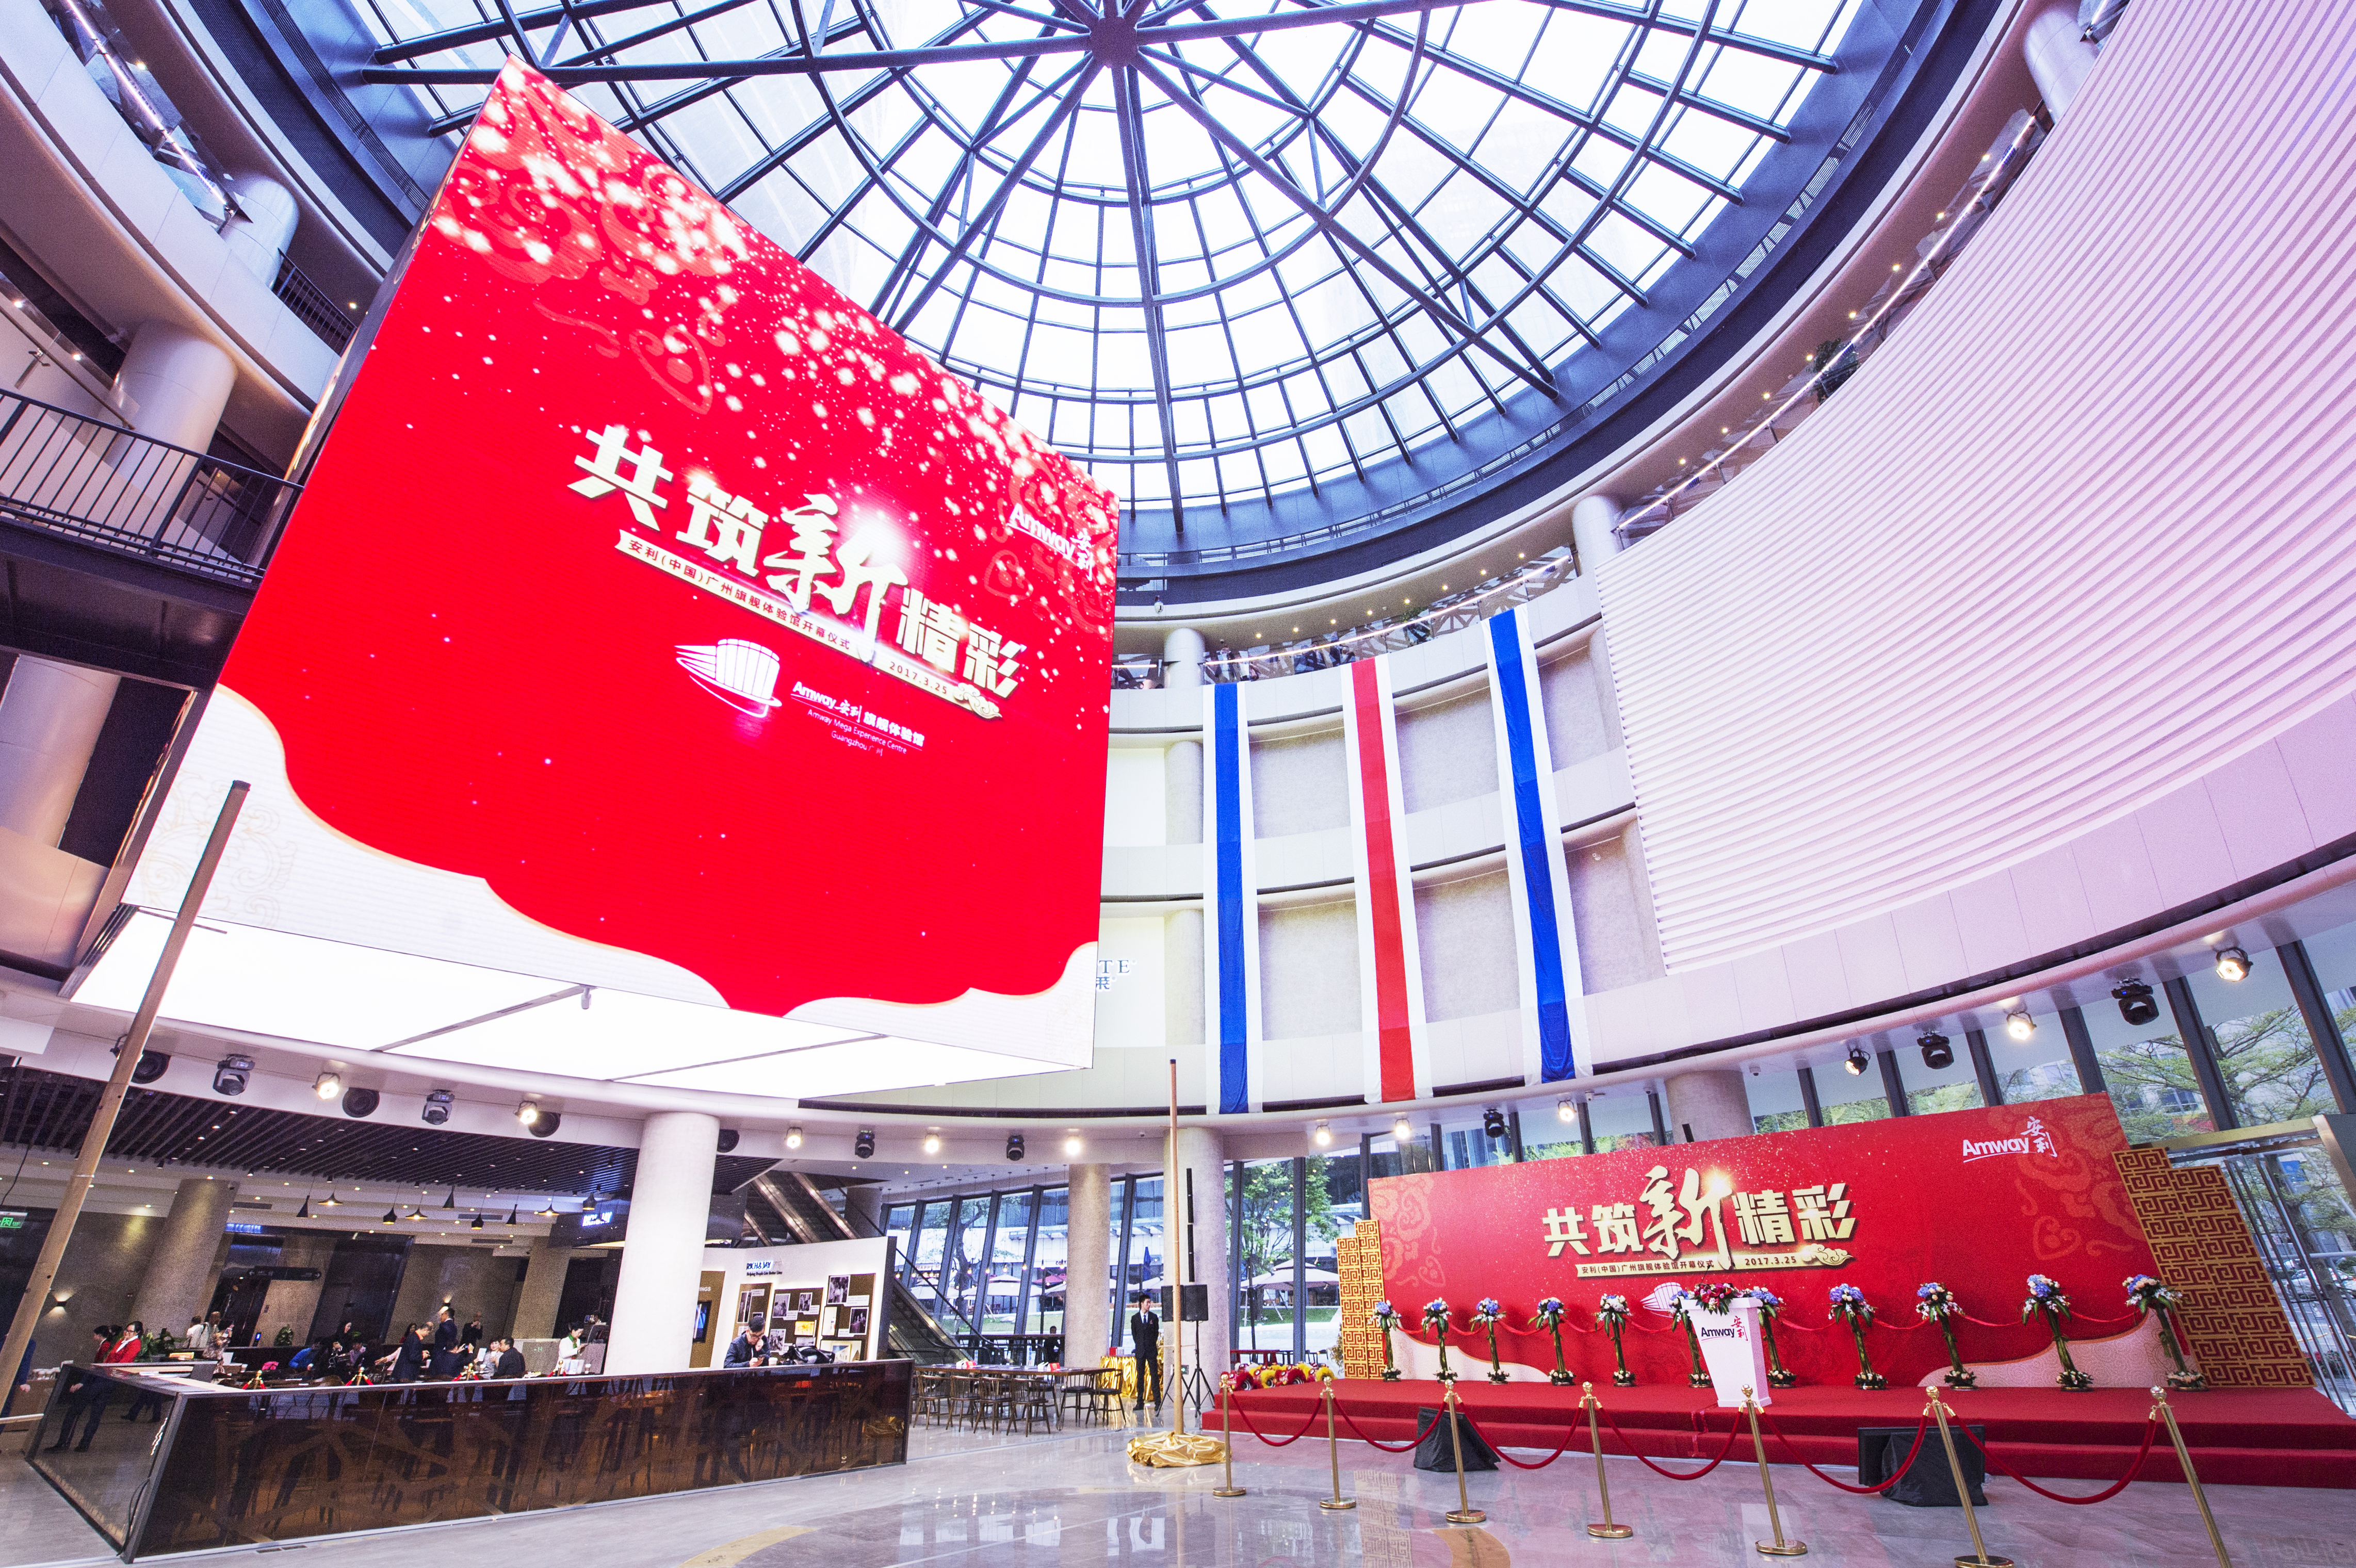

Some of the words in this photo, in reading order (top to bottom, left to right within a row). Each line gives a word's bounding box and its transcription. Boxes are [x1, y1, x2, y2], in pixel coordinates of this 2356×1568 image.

[567, 424, 1027, 698] 共筑新精彩
[1009, 503, 1075, 560] Amway
[1070, 528, 1093, 581] 安利
[889, 661, 947, 694] 2017.3.25
[792, 681, 836, 709] Amway
[863, 711, 924, 747] 旗舰体验馆
[807, 709, 832, 725] Amway
[833, 718, 852, 732] Mega
[853, 727, 886, 746] Experience
[887, 741, 907, 754] Centre
[831, 730, 867, 750] Guangzhou
[1963, 1137, 2029, 1156] Amway
[2020, 1116, 2057, 1157] 安利
[1542, 1165, 1856, 1270] 共筑新精彩
[1745, 1255, 1797, 1266] 2017.3.25
[1701, 1327, 1734, 1338] Amway
[1730, 1315, 1748, 1341] 安利
